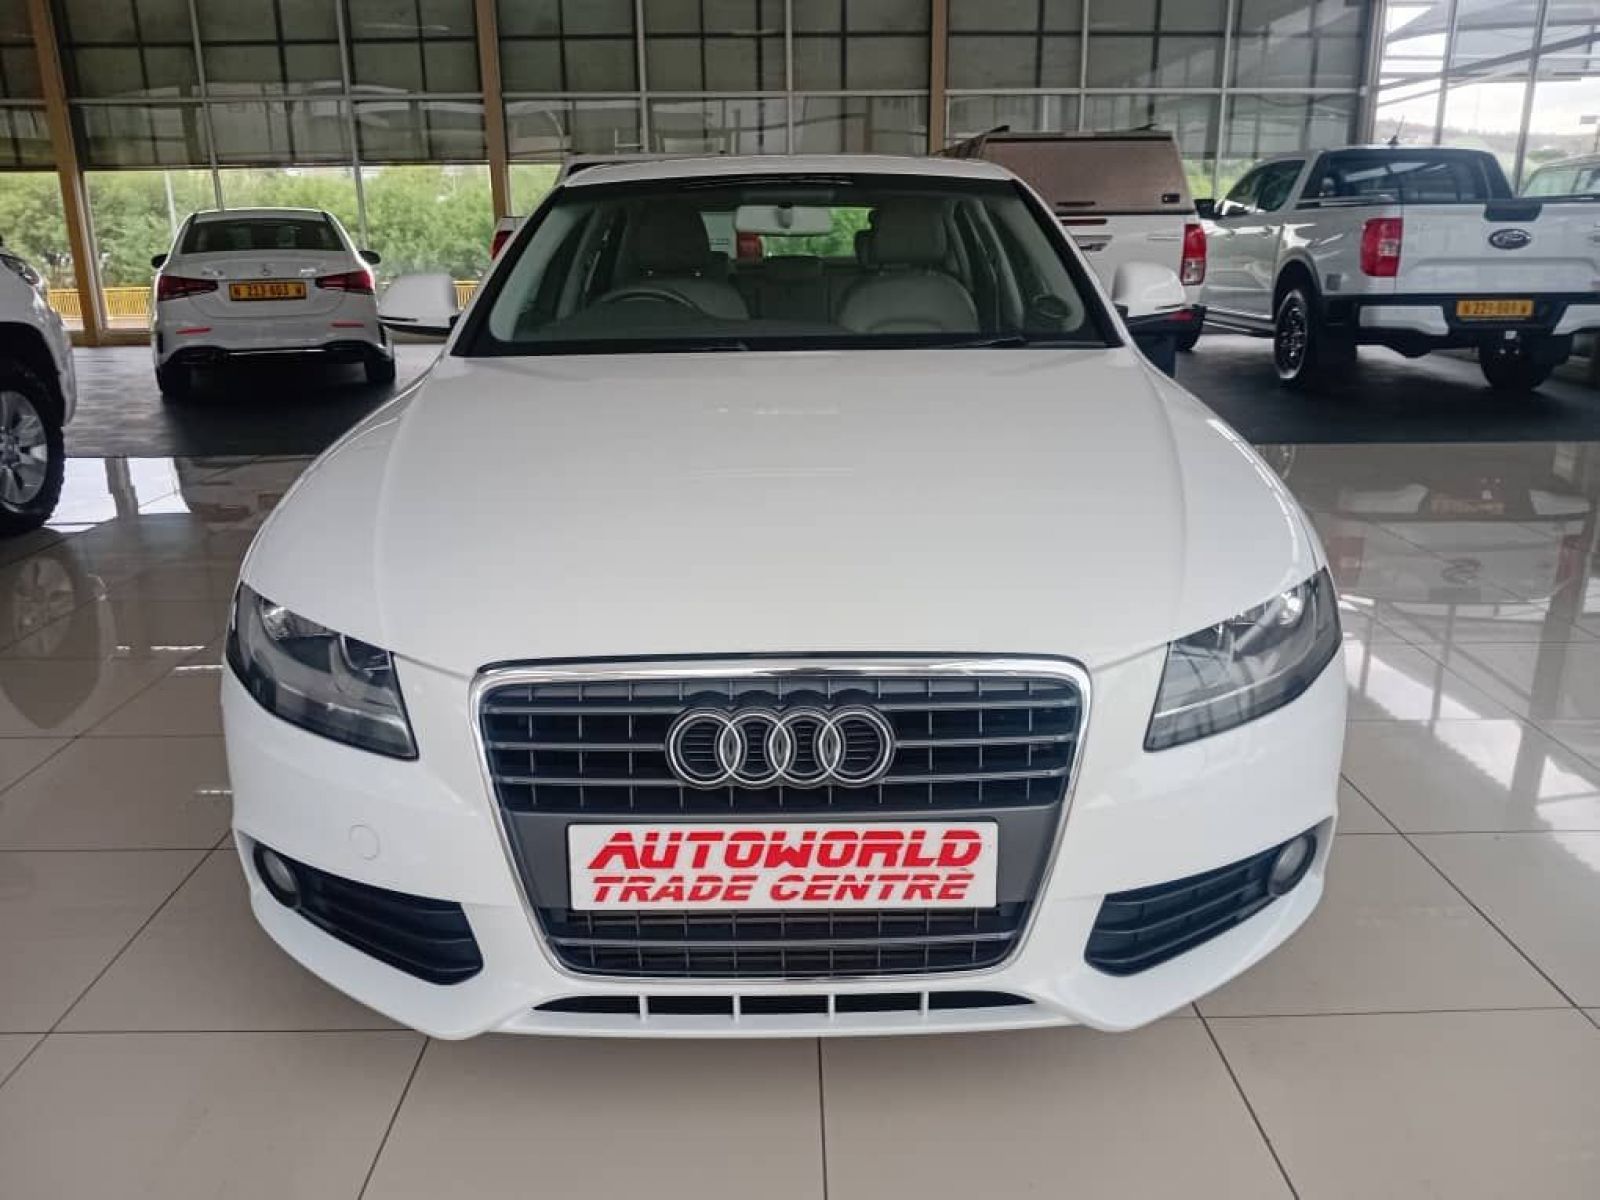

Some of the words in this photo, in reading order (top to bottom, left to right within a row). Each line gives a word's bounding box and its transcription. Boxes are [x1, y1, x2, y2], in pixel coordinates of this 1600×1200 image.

[587, 829, 983, 870] AUTOWORLD
[593, 873, 759, 902] TRADE
[769, 872, 975, 902] CENTRE
